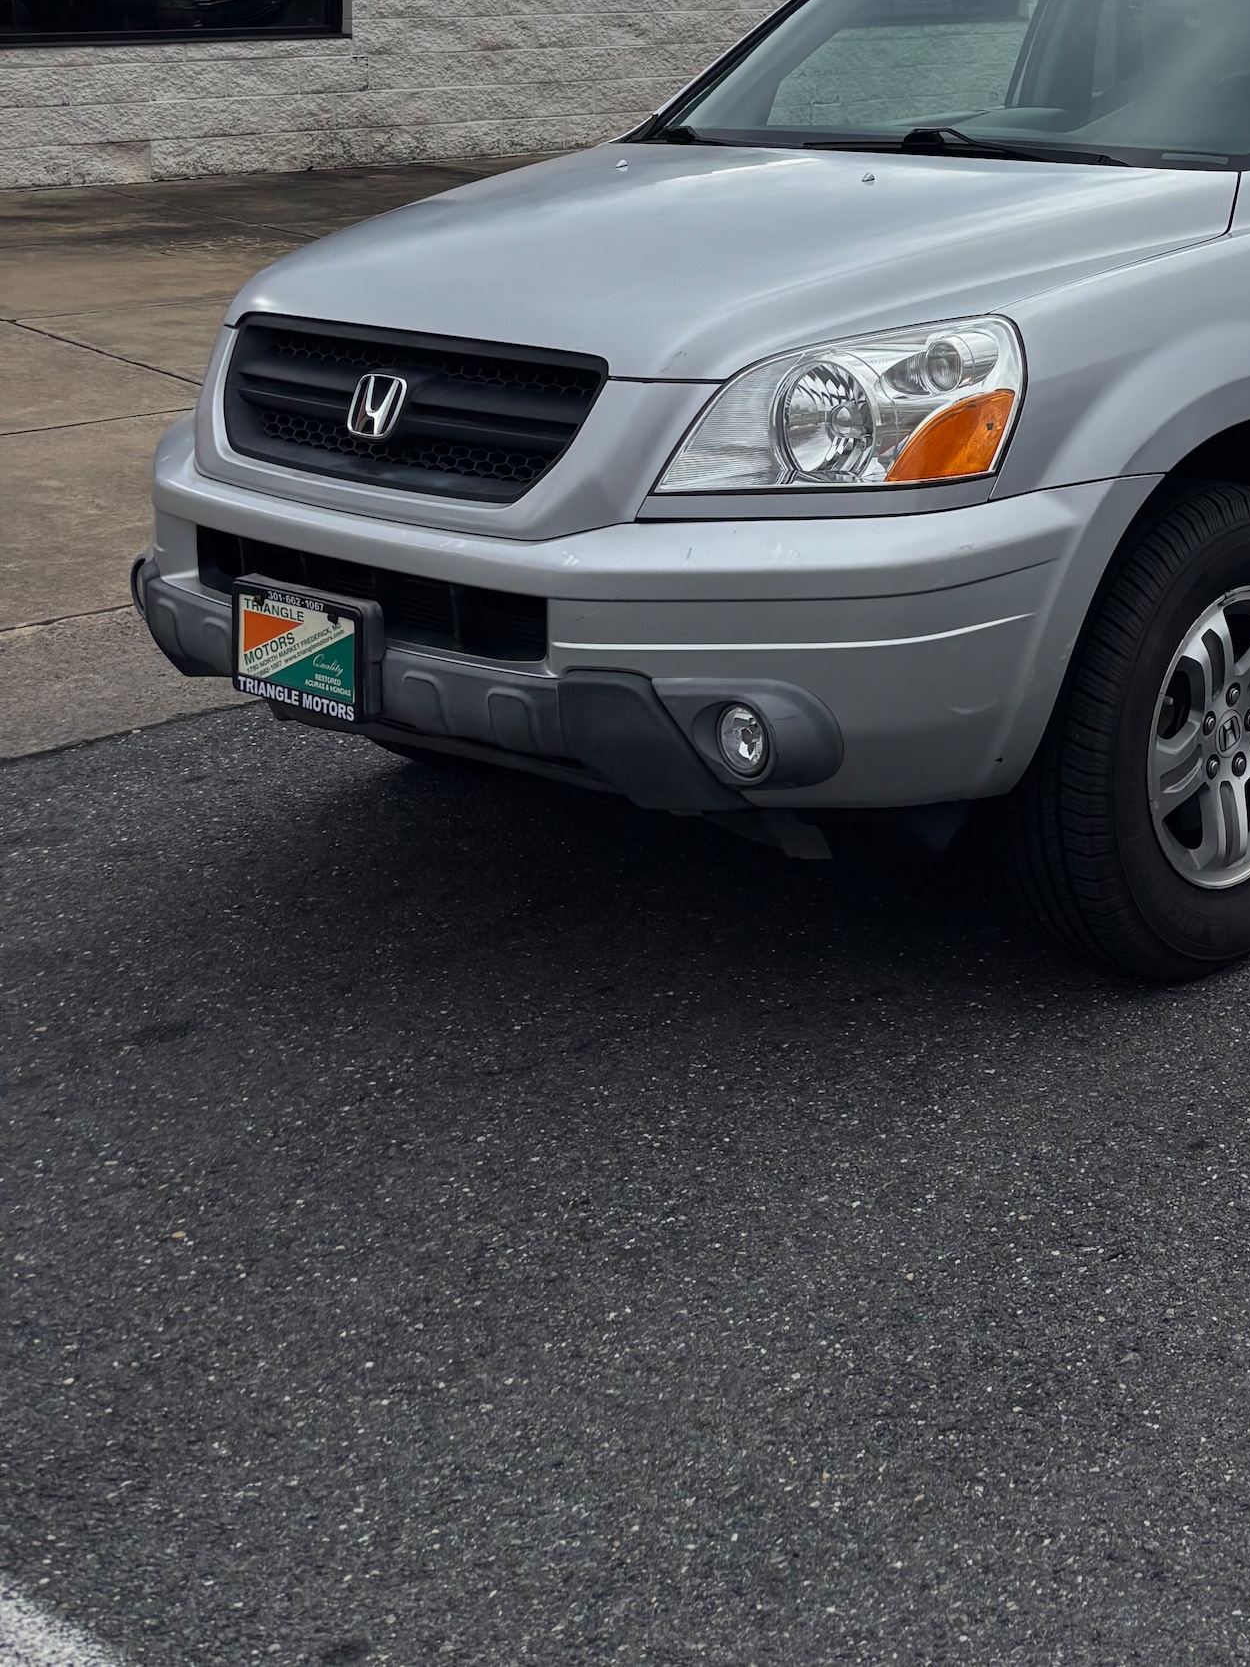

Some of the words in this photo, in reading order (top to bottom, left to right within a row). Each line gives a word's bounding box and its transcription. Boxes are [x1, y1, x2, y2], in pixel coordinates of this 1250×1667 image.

[244, 632, 295, 665] MOTORS
[313, 653, 344, 677] Quality
[237, 675, 300, 706] TRIANGLE
[302, 693, 355, 722] MOTORS
